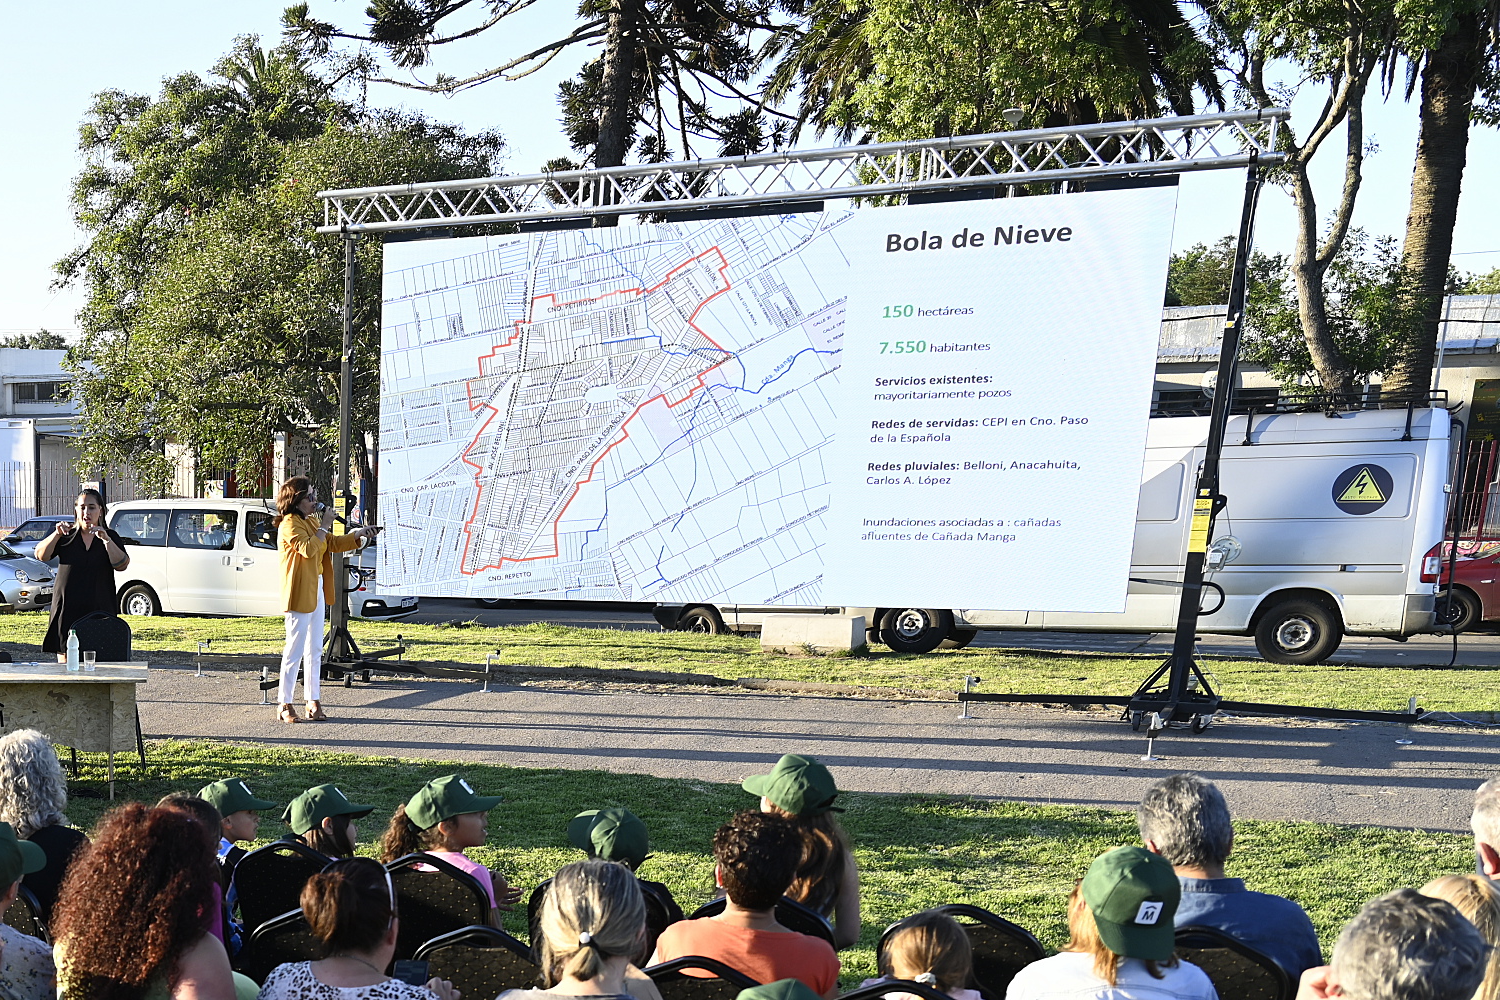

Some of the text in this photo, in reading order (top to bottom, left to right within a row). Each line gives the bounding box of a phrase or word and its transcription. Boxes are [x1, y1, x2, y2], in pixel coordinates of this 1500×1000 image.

[886, 224, 1072, 252] Bola de Nieve
[882, 304, 974, 319] 150 hectáreas
[879, 340, 990, 354] 7.550 habitantes
[875, 374, 993, 387] Servicios existentes:
[874, 388, 1012, 402] mayoritariamente pozos
[872, 420, 907, 429] Redes
[909, 419, 923, 428] de
[926, 418, 978, 427] servidas:
[982, 417, 1008, 427] CEPI
[1030, 416, 1056, 426] Cno.
[1060, 416, 1088, 425] Paso
[870, 432, 951, 443] de la Española
[868, 460, 1081, 473] Redes pluviales: Belloni, Anacahuita,
[430, 480, 456, 489] LACOSTA
[867, 474, 951, 486] Carlos A. López
[863, 517, 935, 527] Inundaciones
[939, 517, 993, 527] asociadas
[1014, 517, 1061, 527] cañadas
[862, 530, 1016, 542] afluentes de Cañada Manga
[488, 570, 531, 582] CNO. REPETTO
[1142, 911, 1155, 920] M
